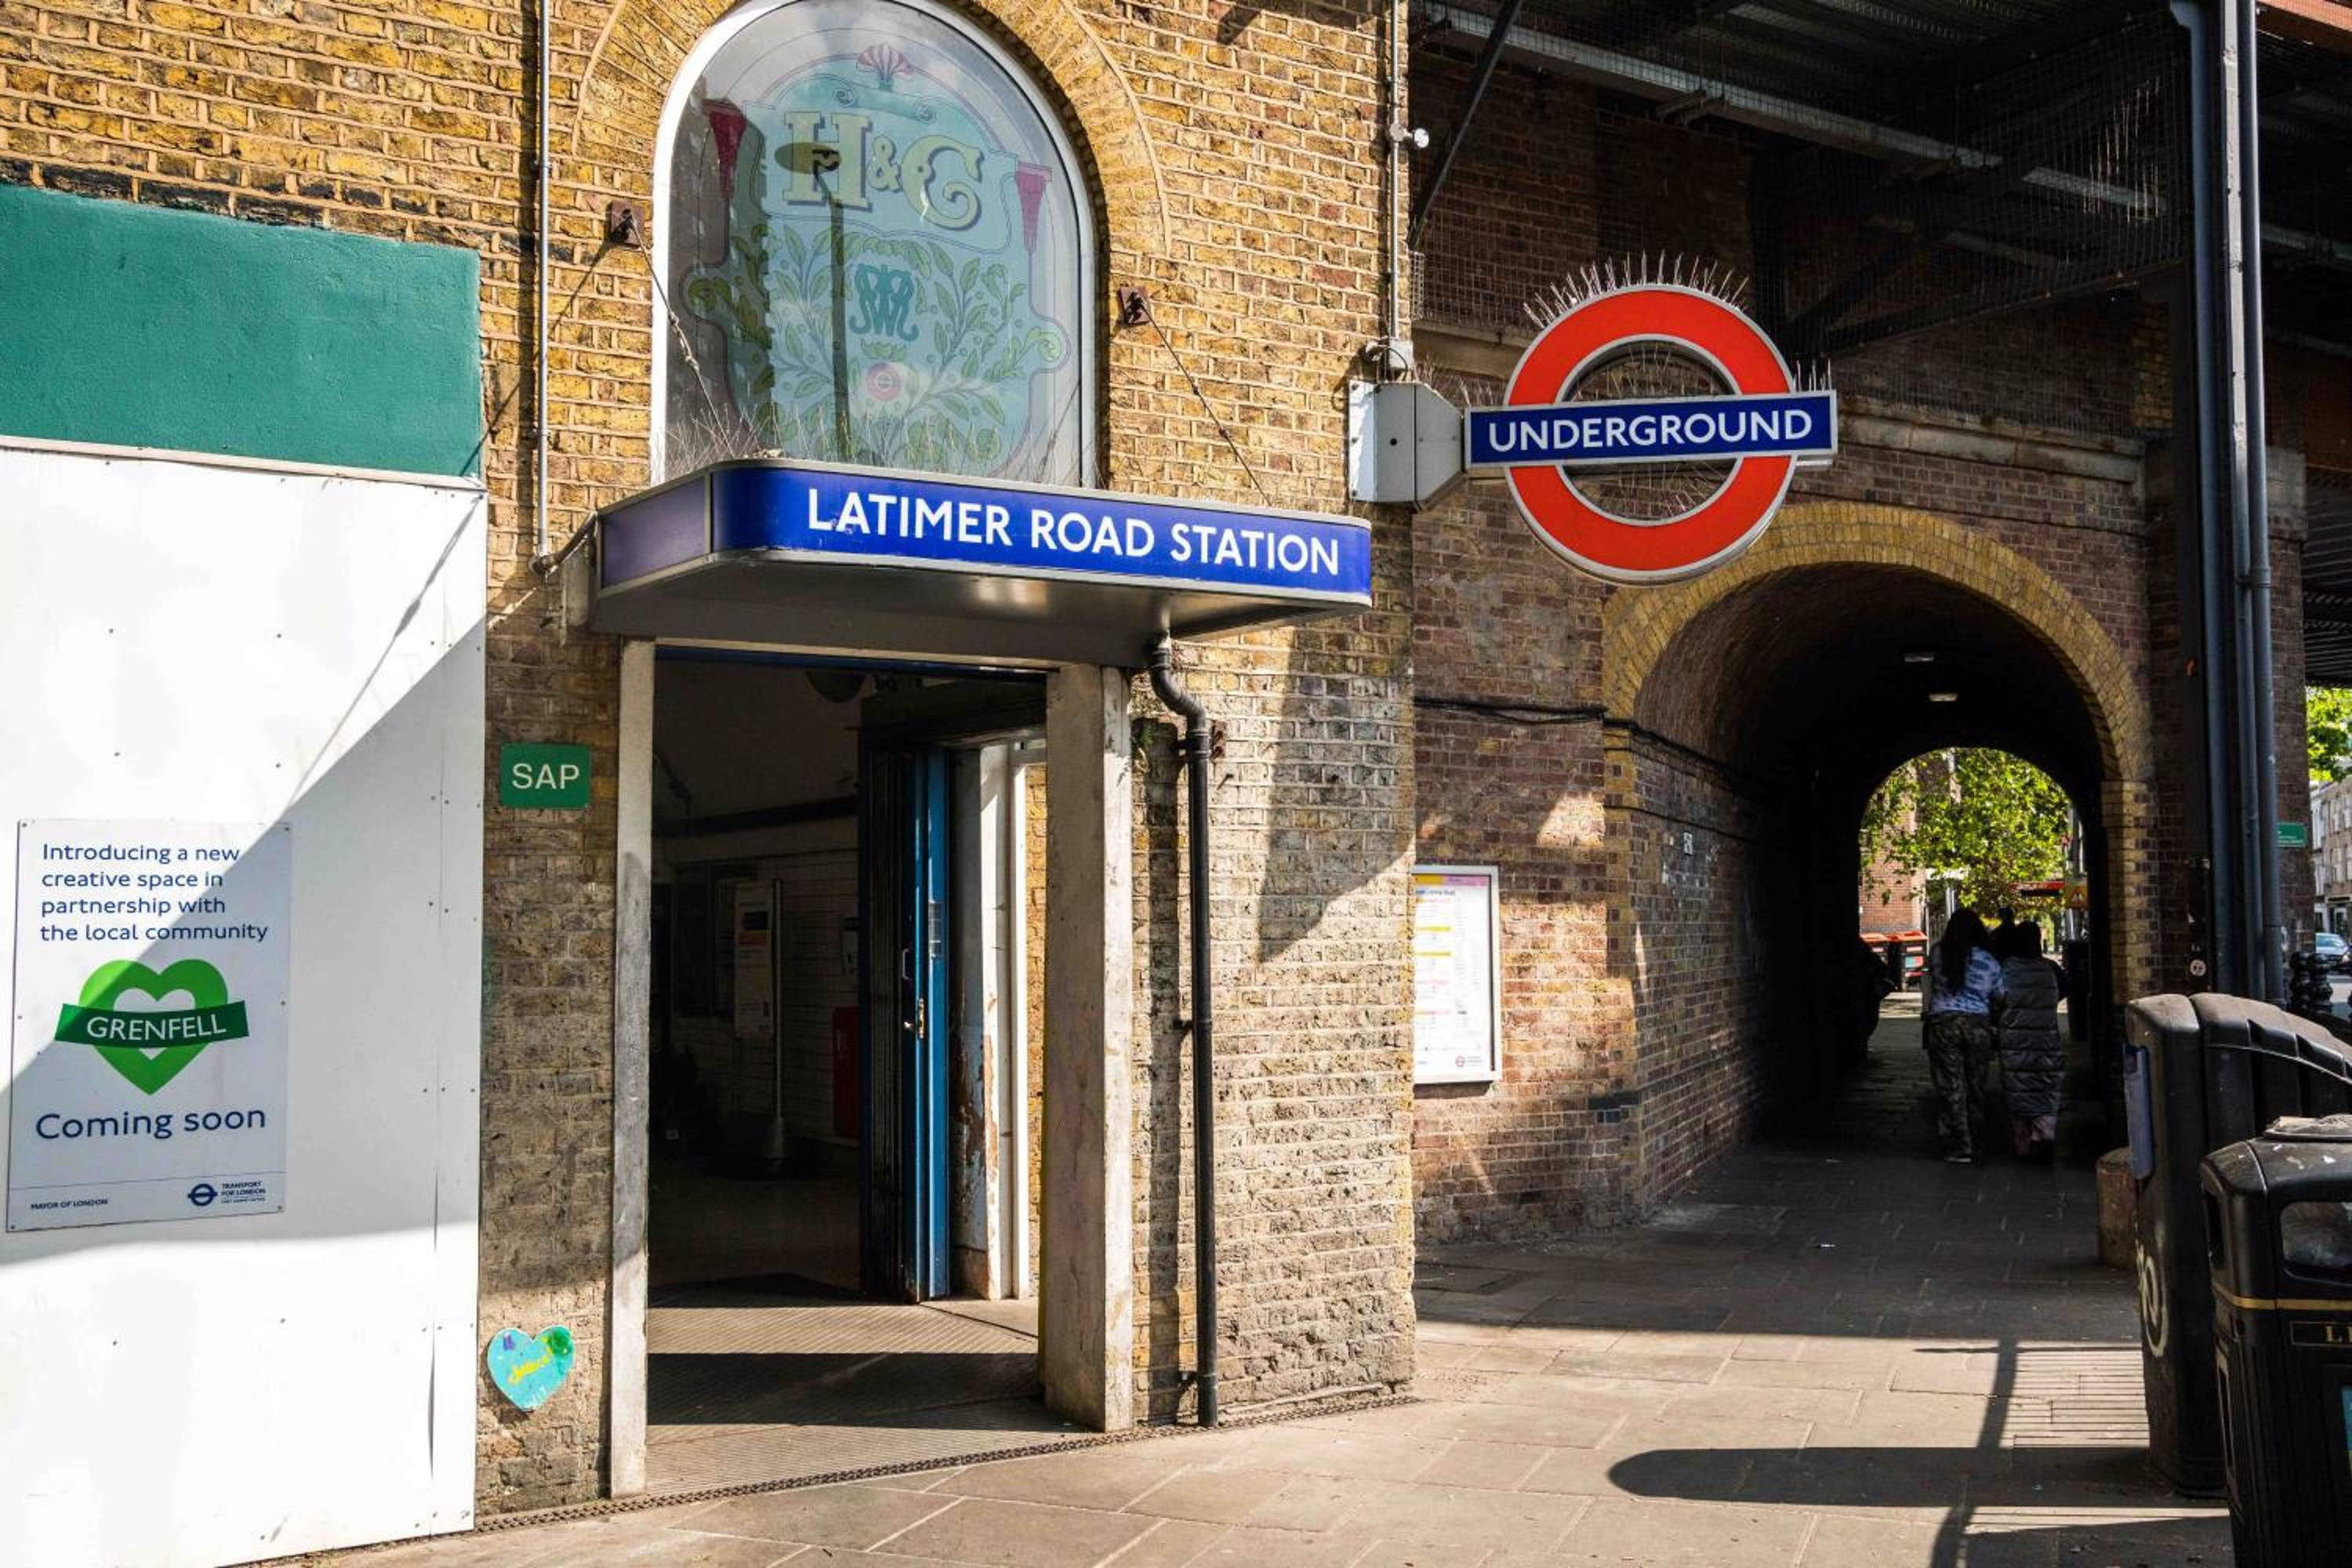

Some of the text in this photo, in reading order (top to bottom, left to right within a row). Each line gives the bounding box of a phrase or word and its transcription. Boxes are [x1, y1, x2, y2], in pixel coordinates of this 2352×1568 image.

[1489, 409, 1813, 452] UNDERGROUND
[808, 488, 1339, 575] LATIMER ROAD STATION
[512, 763, 580, 789] SAP
[43, 843, 240, 864] Introducing a new
[42, 871, 223, 891] creative space in
[41, 898, 226, 917] partnership with
[40, 924, 269, 942] the local community
[86, 1013, 227, 1041] GRENFELL
[35, 1109, 266, 1139] Coming soon
